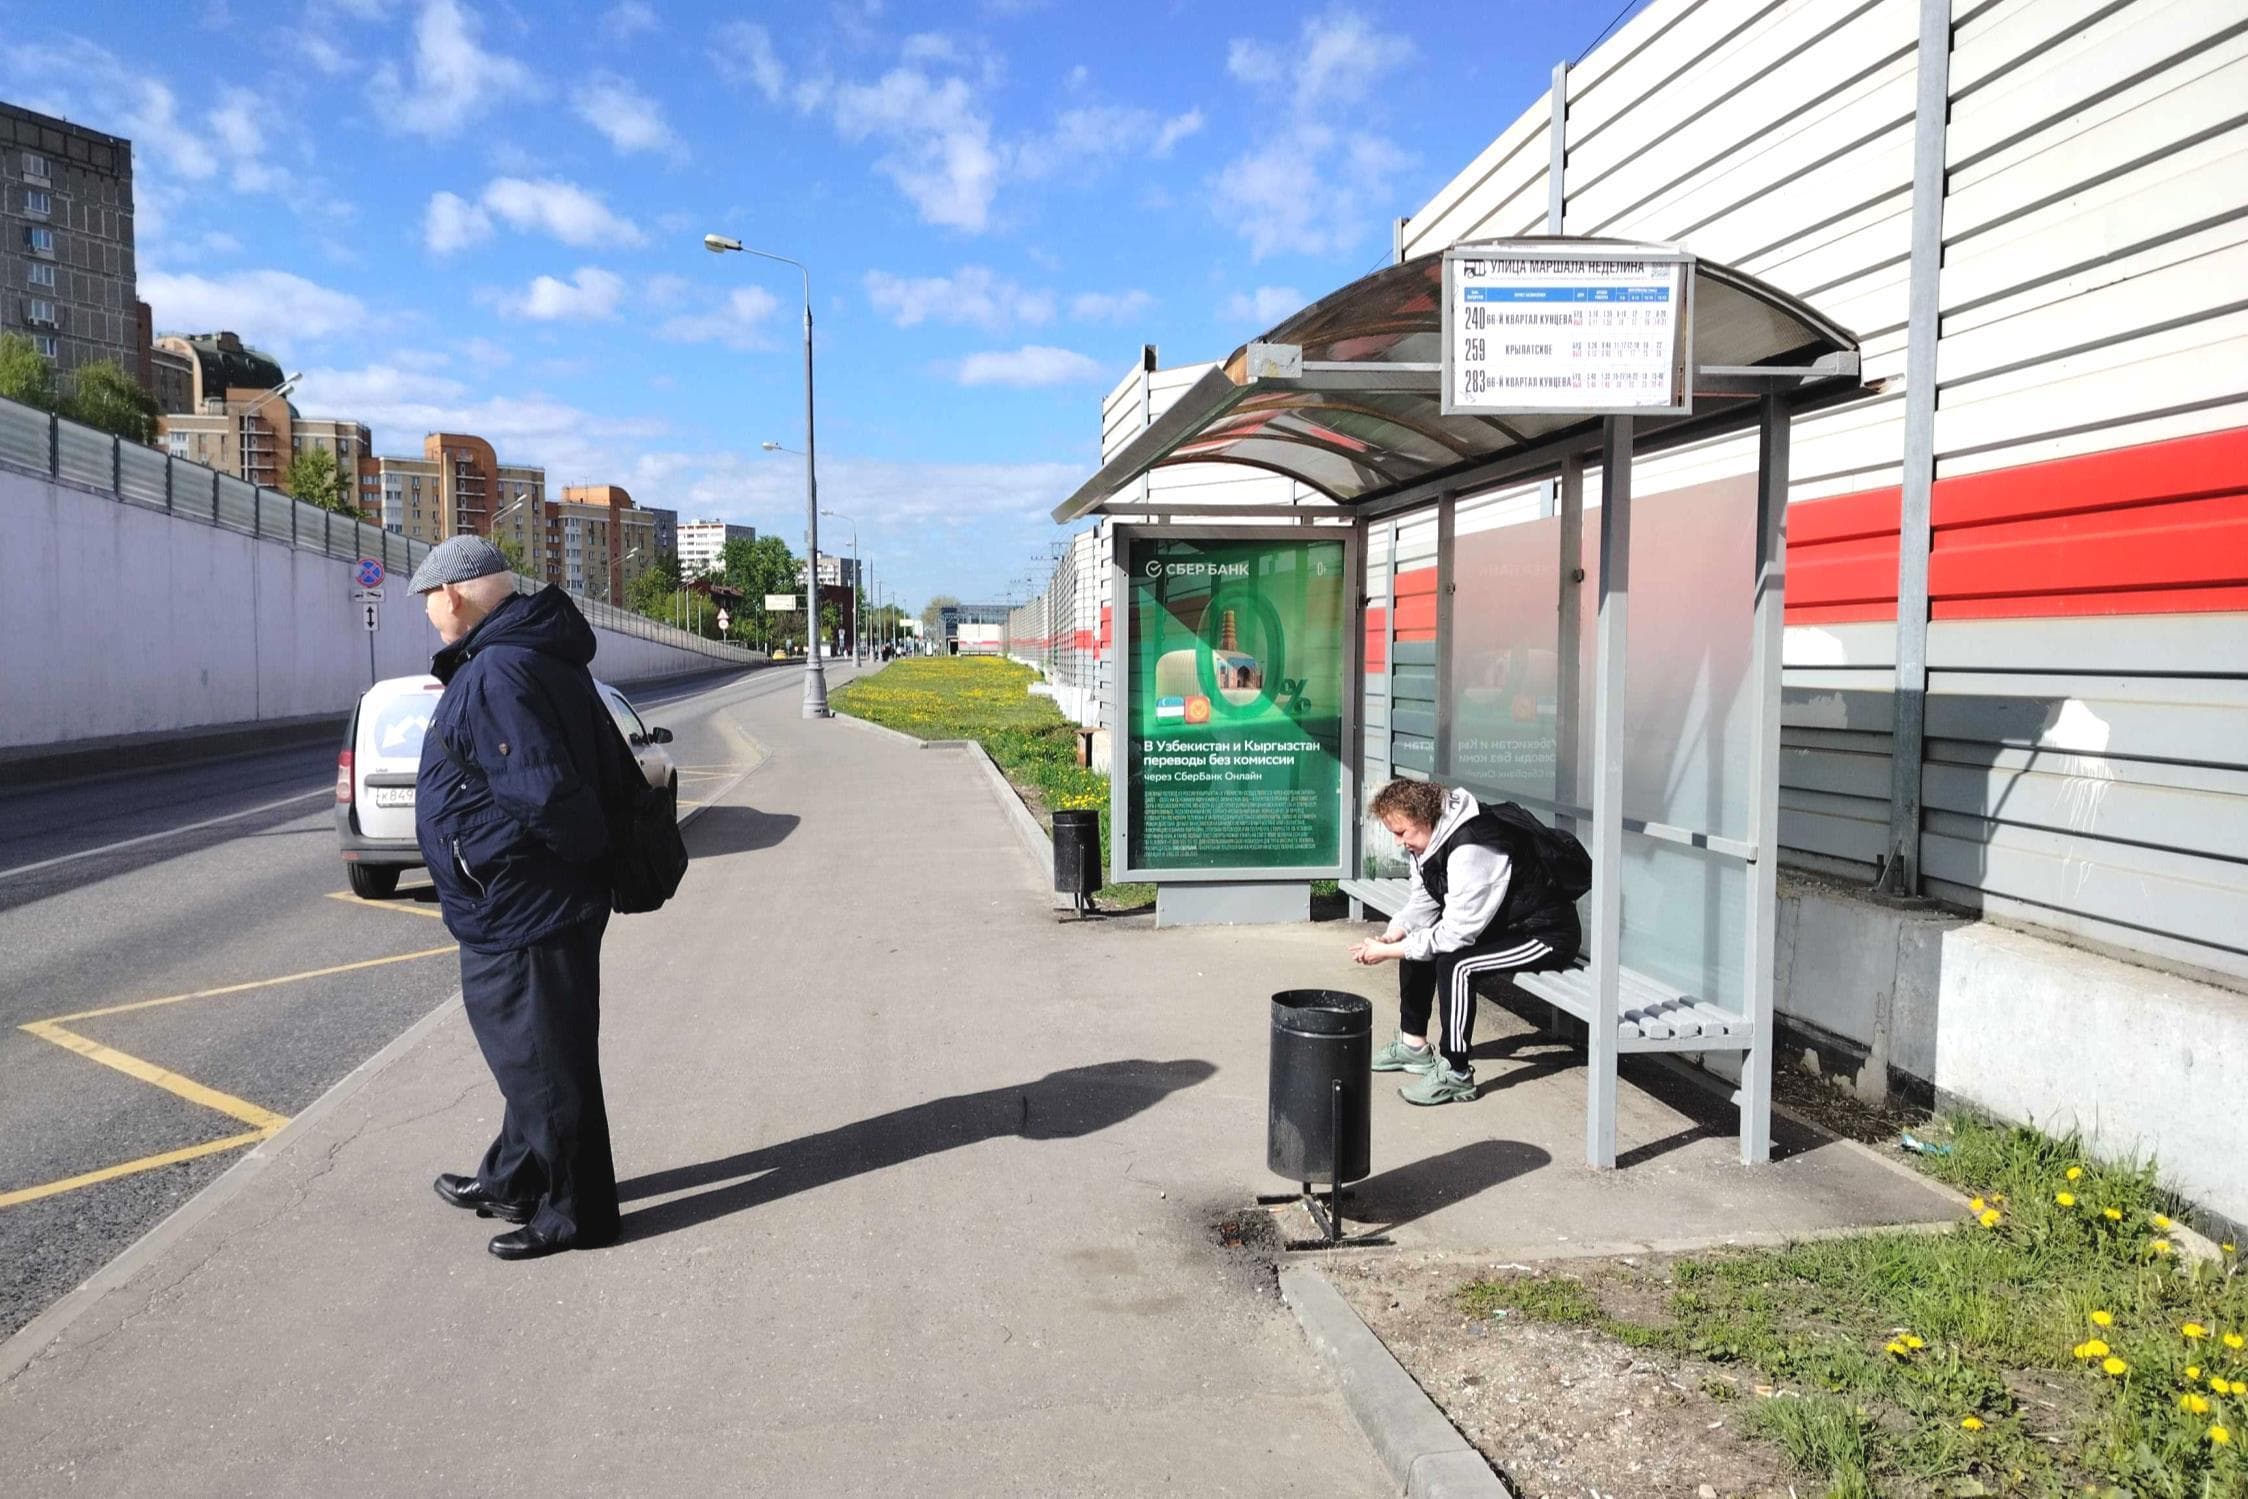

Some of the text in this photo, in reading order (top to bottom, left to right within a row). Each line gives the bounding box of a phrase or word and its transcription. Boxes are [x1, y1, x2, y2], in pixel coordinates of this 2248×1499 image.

[1491, 260, 1526, 276] УЛИЦА
[1530, 260, 1585, 274] МАРШАЛА
[1588, 261, 1645, 276] НЕДЕЛИНА
[1465, 306, 1485, 330] 240
[1506, 314, 1538, 325] КВАРТАЛ
[1540, 314, 1572, 326] КУНЦЕВА
[1465, 338, 1485, 361] 259
[1506, 344, 1552, 355] КРЫЛАТСКОЕ
[1465, 370, 1485, 392] 283
[1506, 376, 1538, 388] КВАРТАЛ
[1540, 376, 1572, 389] КУНЦЕВА
[1144, 740, 1320, 754] В Узбекистан и Кыргызстан
[1144, 754, 1294, 768] переводы без комиссии
[1144, 771, 1262, 783] через СберБанк Онлайн
